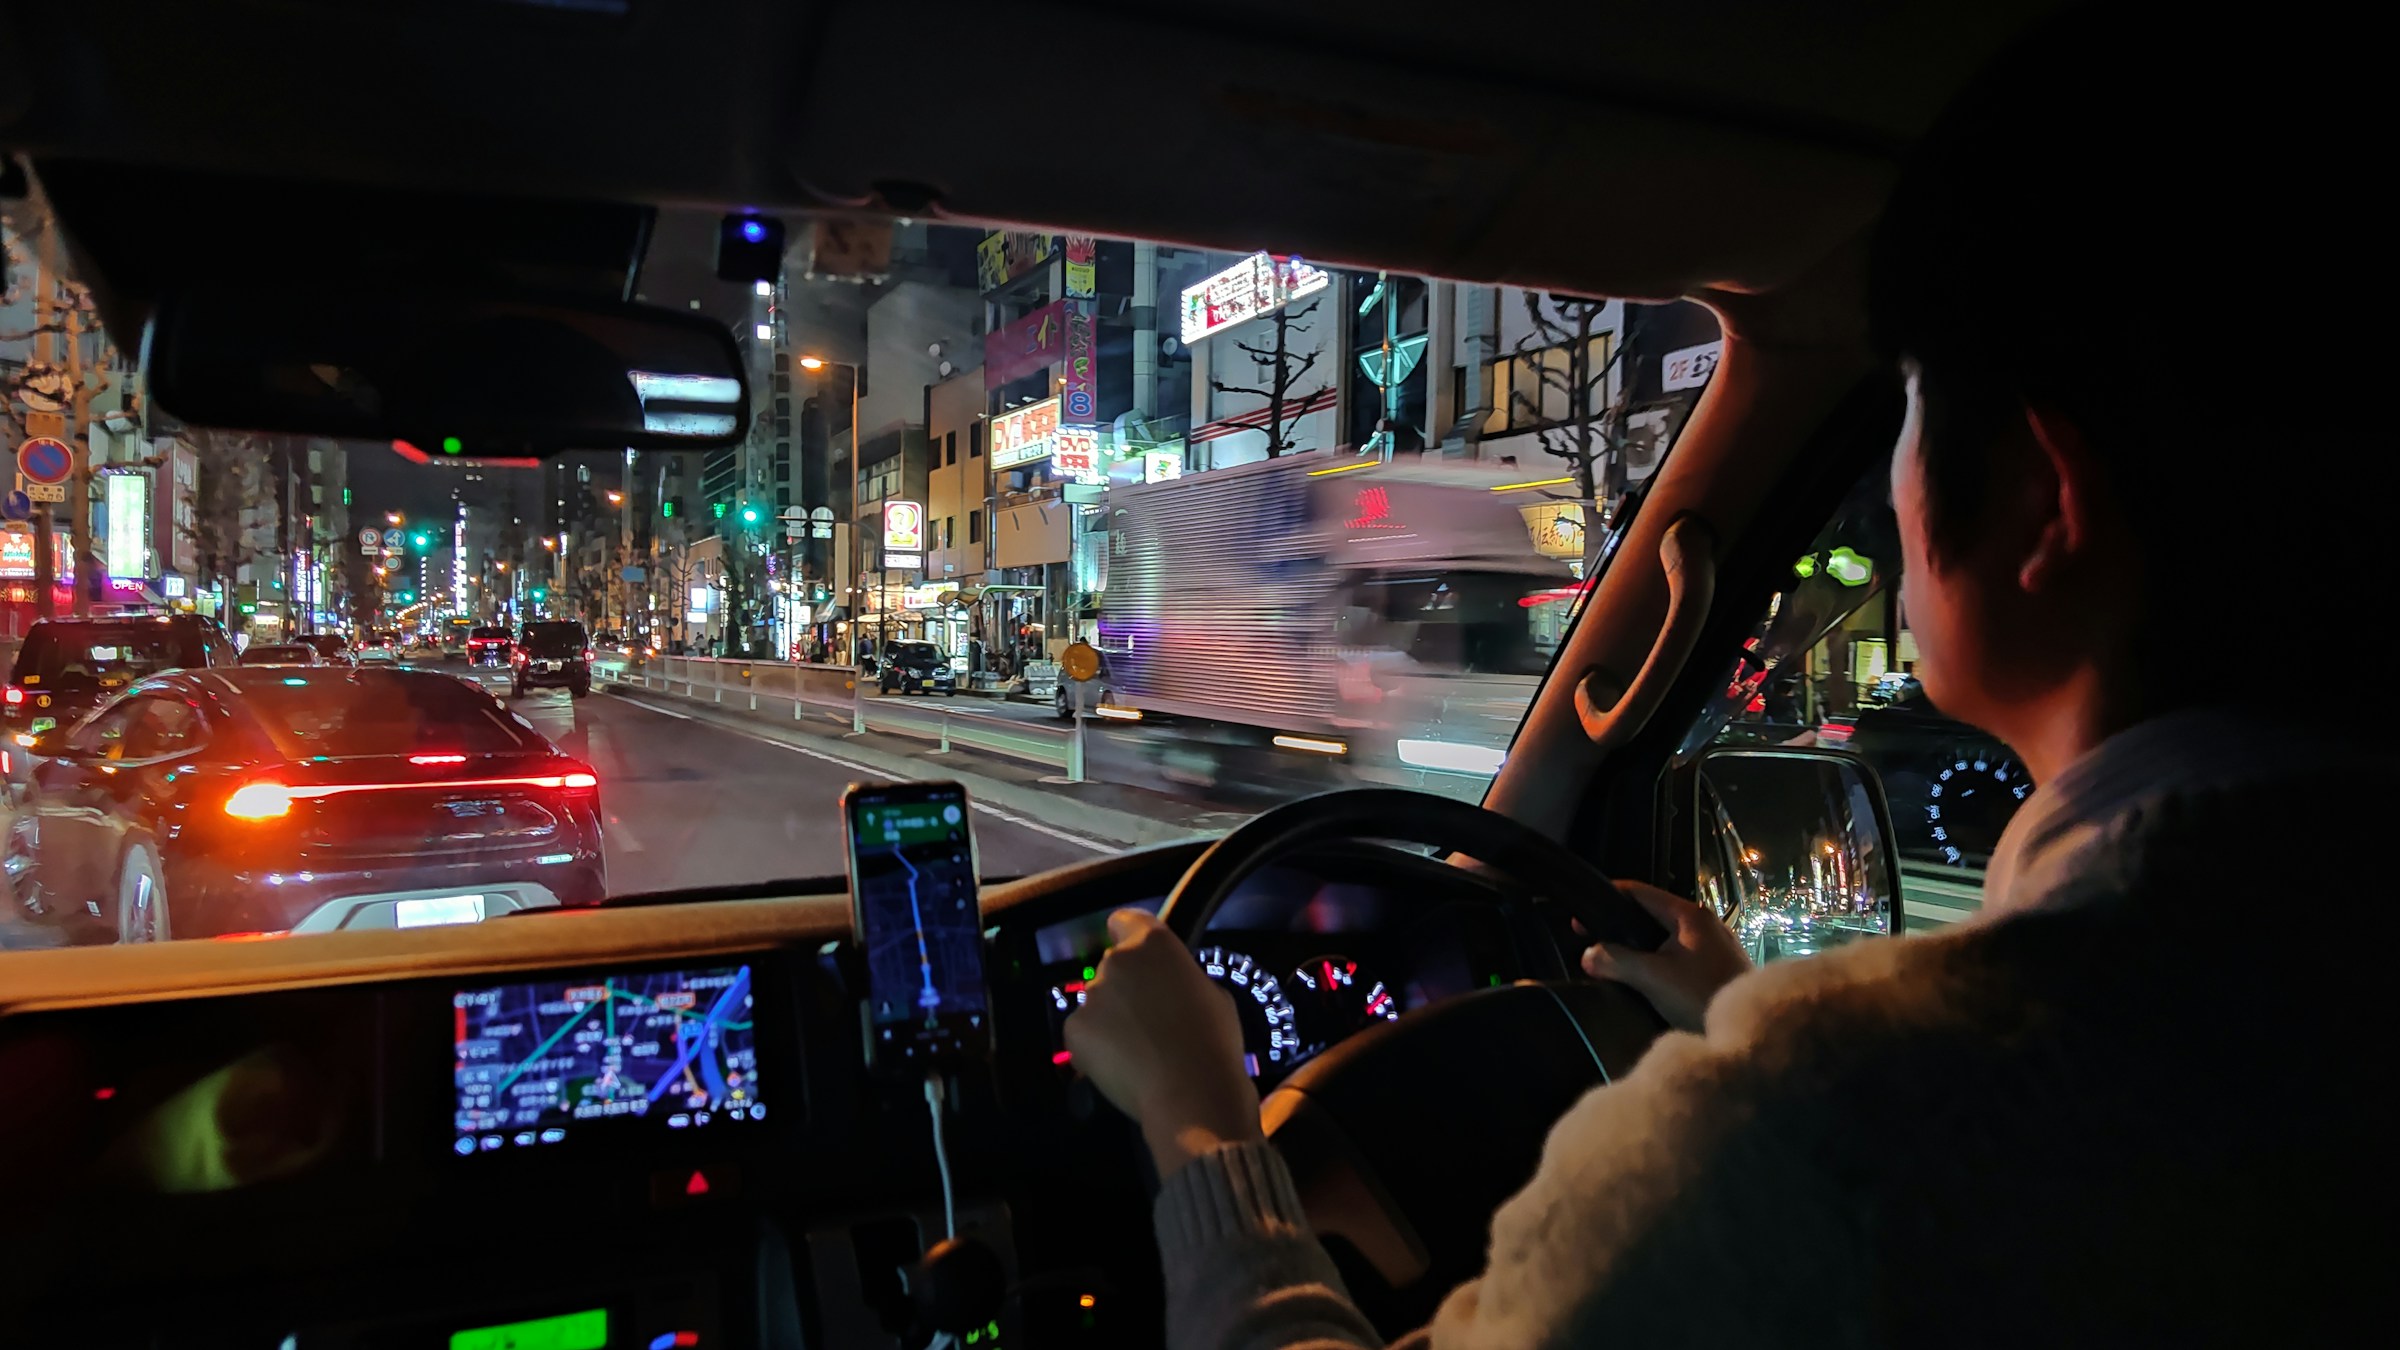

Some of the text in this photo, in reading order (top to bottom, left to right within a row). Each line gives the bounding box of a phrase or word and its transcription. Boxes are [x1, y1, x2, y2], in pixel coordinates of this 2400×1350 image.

[1068, 391, 1093, 416] 8
[1060, 436, 1090, 452] DVD
[112, 582, 144, 592] OPEN
